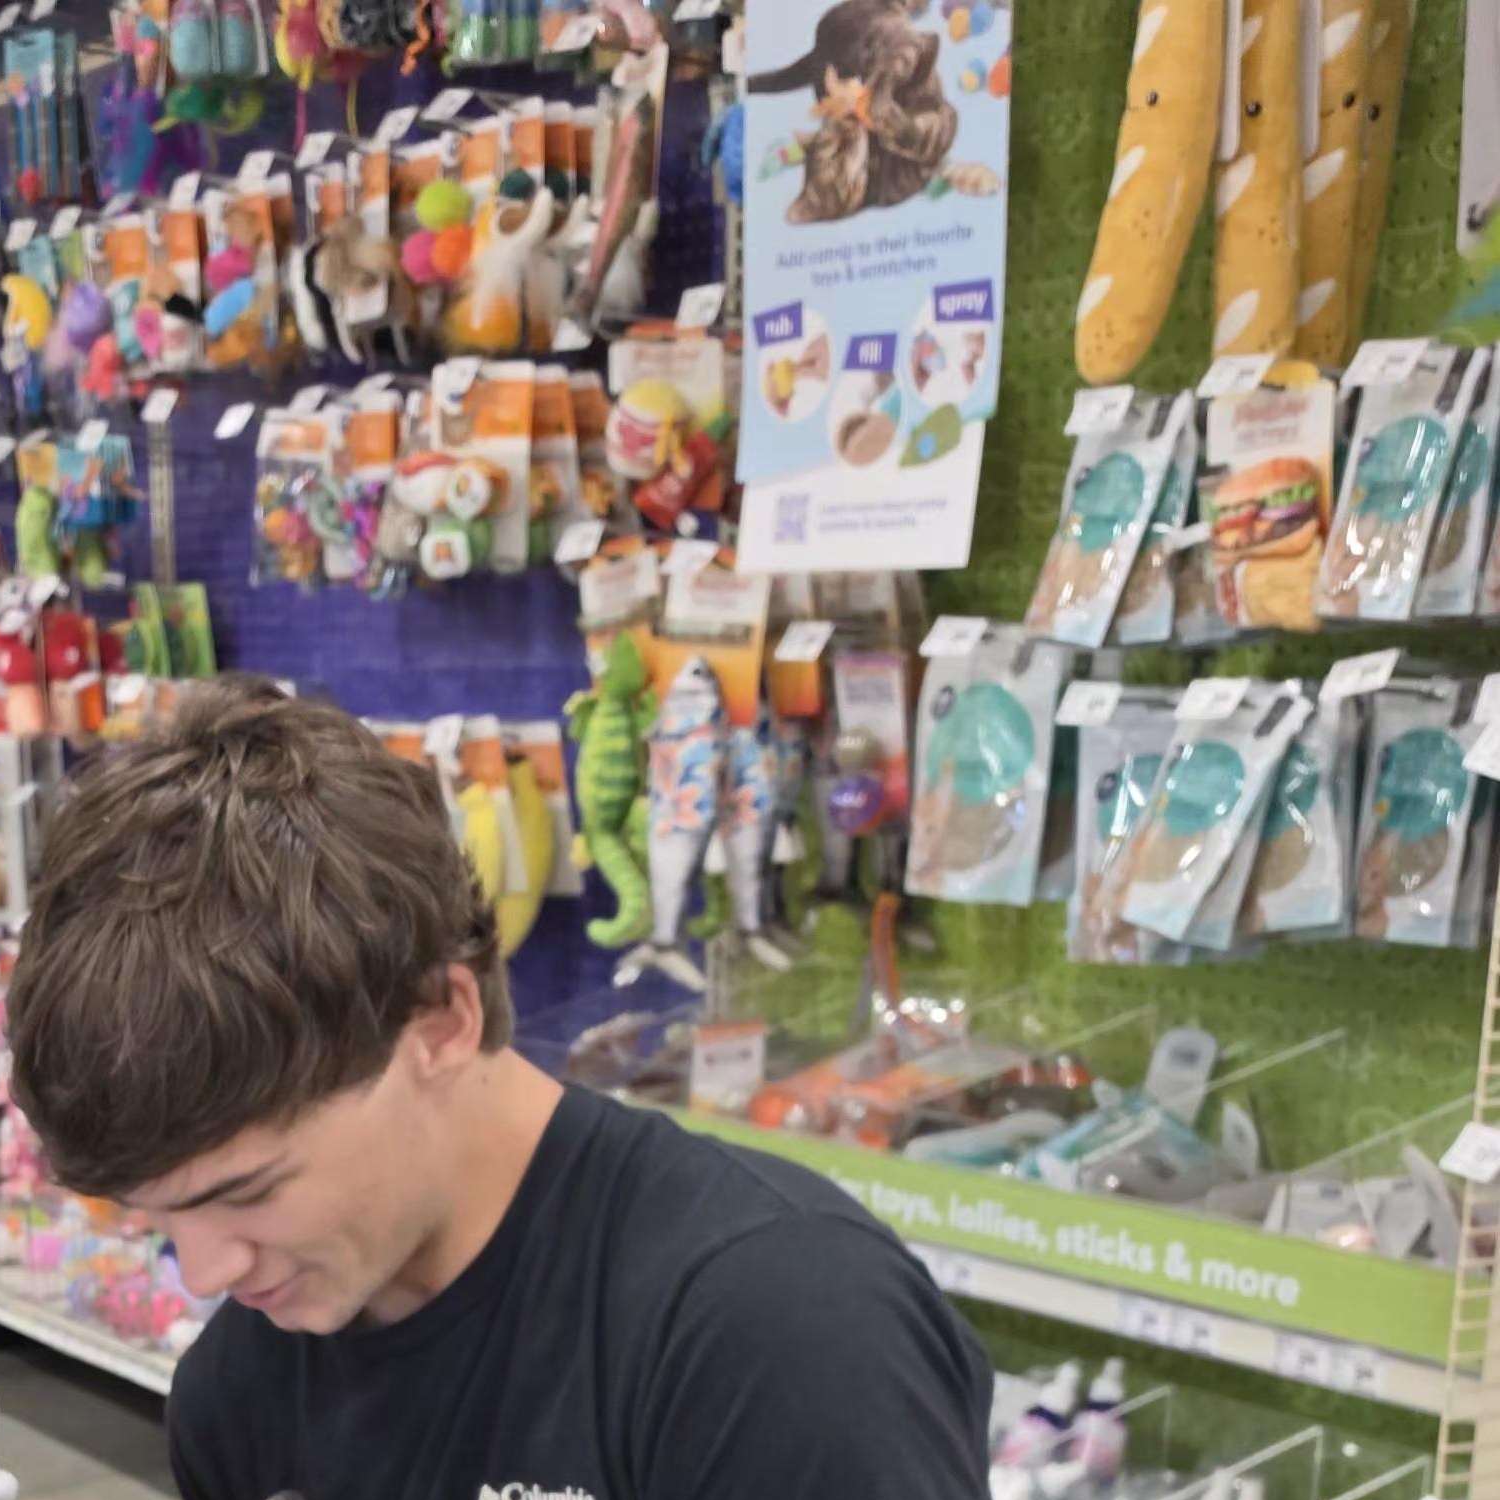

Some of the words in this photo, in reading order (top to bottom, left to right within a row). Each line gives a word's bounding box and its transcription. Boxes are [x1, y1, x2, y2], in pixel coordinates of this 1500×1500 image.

[764, 313, 794, 337] rub
[870, 1180, 942, 1228] toys,
[948, 1191, 1050, 1252] lollies,
[1055, 1222, 1156, 1275] sticks
[1163, 1240, 1193, 1284] &
[1199, 1258, 1301, 1308] more
